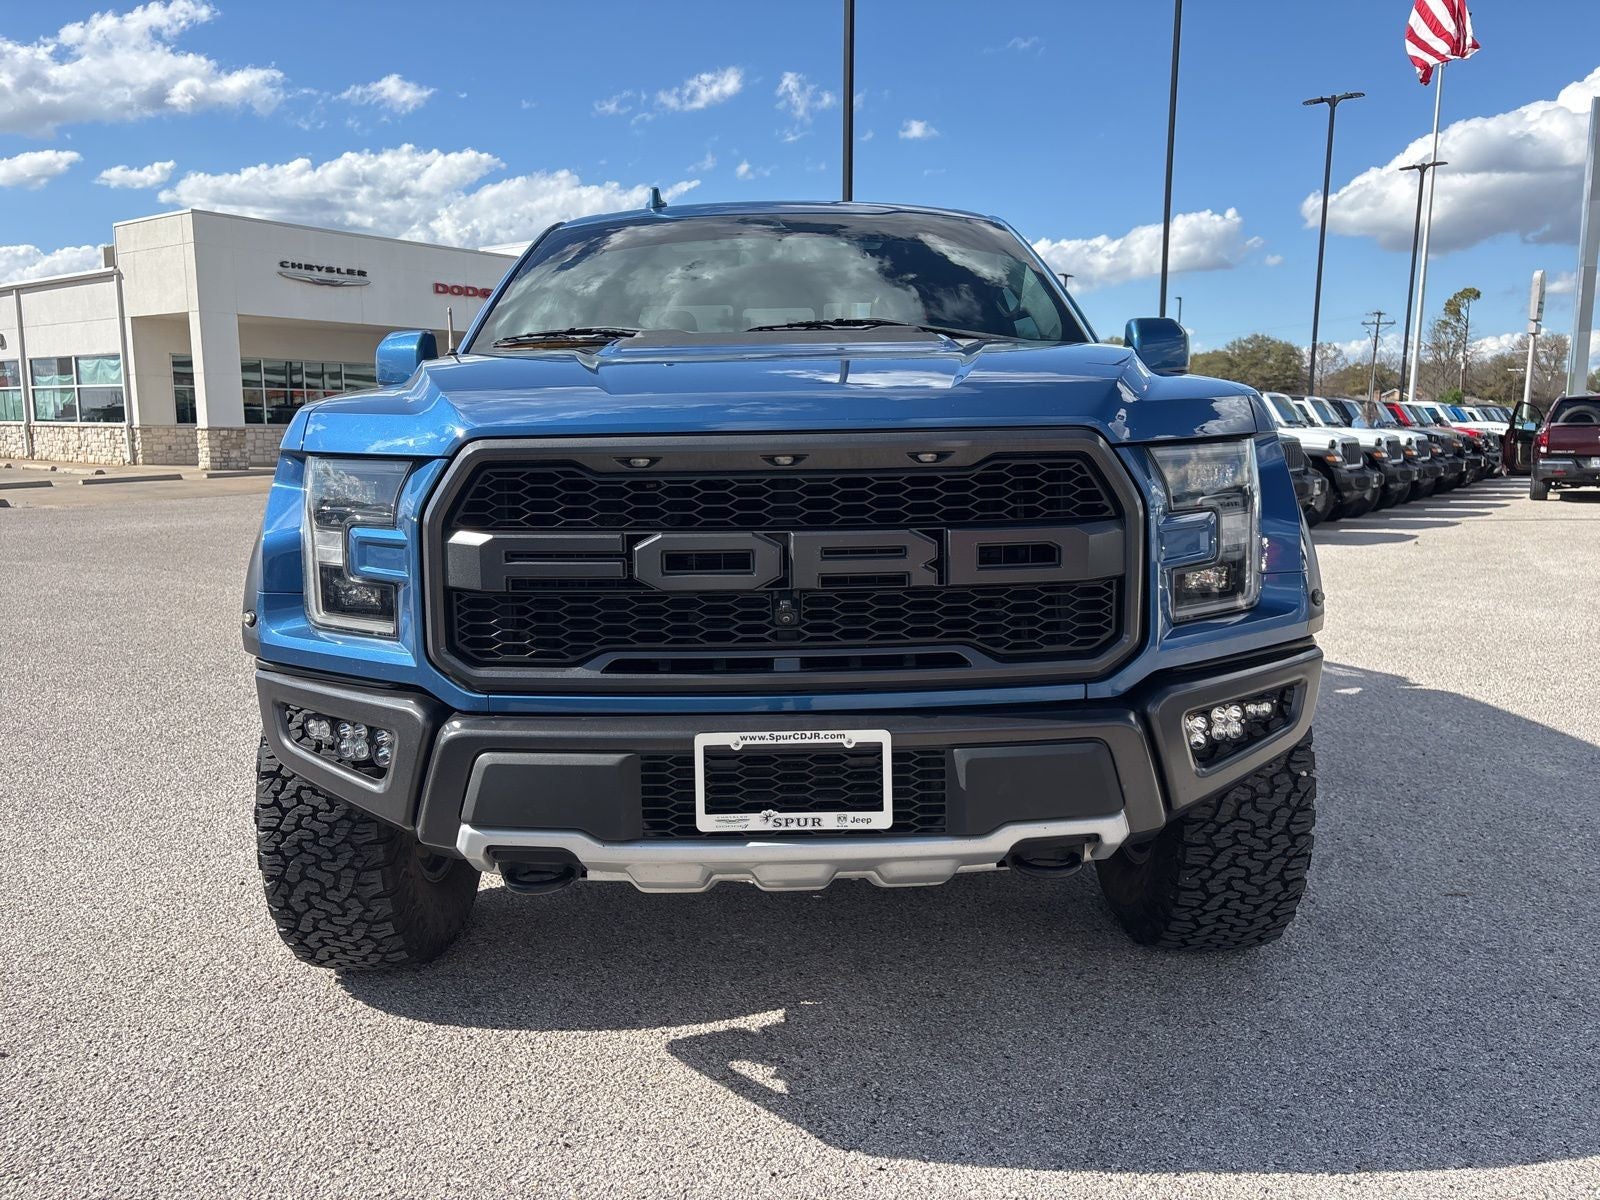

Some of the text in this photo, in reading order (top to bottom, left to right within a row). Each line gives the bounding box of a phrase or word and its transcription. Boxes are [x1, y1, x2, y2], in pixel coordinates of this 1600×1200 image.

[279, 260, 368, 277] CHRYSLER
[433, 283, 495, 299] DODG
[447, 520, 1126, 592] FORD
[739, 732, 846, 743] www.SpurCDJR.com
[772, 817, 822, 828] SPUR
[850, 816, 872, 825] Jeep
